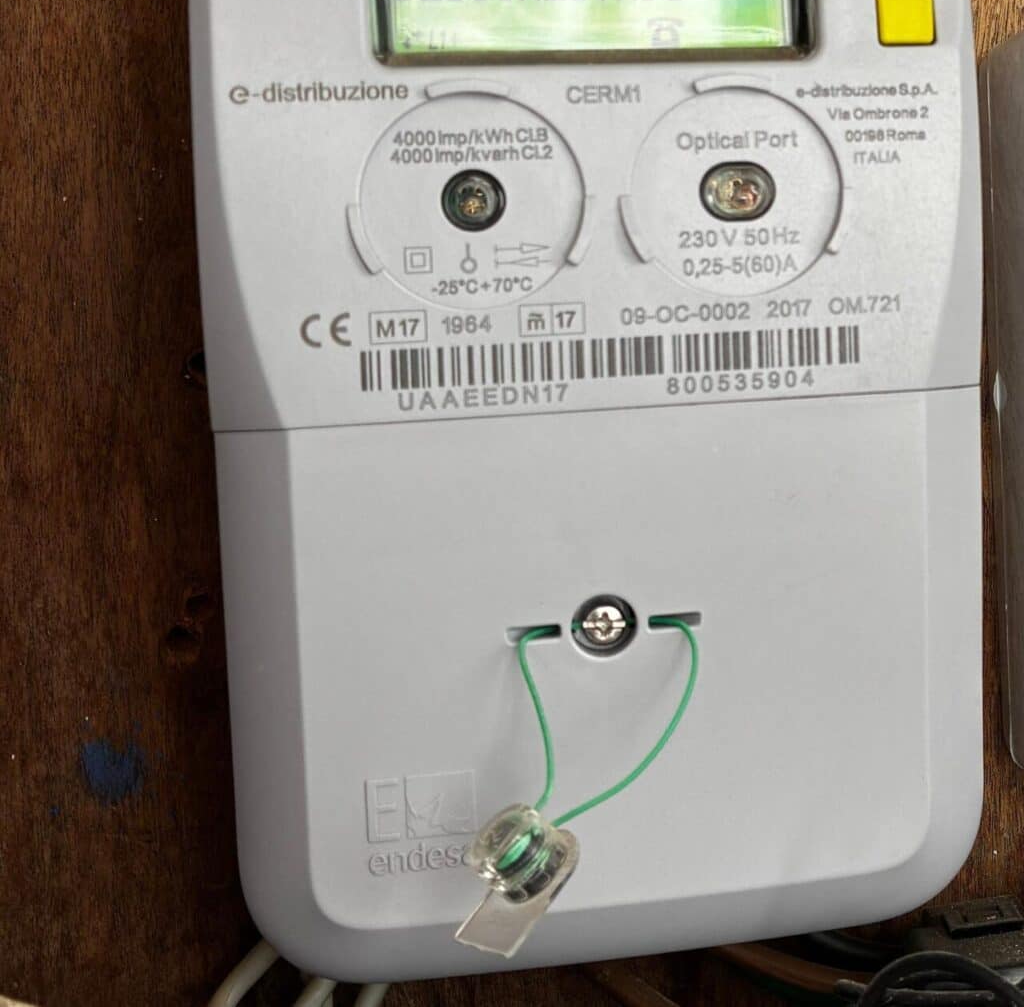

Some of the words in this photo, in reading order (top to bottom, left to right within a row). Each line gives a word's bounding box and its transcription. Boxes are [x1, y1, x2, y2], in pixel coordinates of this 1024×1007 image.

[229, 79, 409, 105] e-distribuzione
[565, 84, 641, 105] CERM1
[919, 105, 929, 119] 2
[391, 129, 436, 147] 4000
[676, 131, 750, 153] Optical
[754, 130, 799, 148] Port
[886, 128, 927, 142] Roma
[389, 148, 433, 164] 4000
[853, 149, 902, 165] ITALIA
[678, 230, 719, 249] 230
[743, 227, 770, 246] 50
[766, 298, 813, 319] 2017
[441, 314, 492, 335] 1964
[666, 369, 815, 395] 800535904
[397, 383, 569, 411] UAAEEDN17
